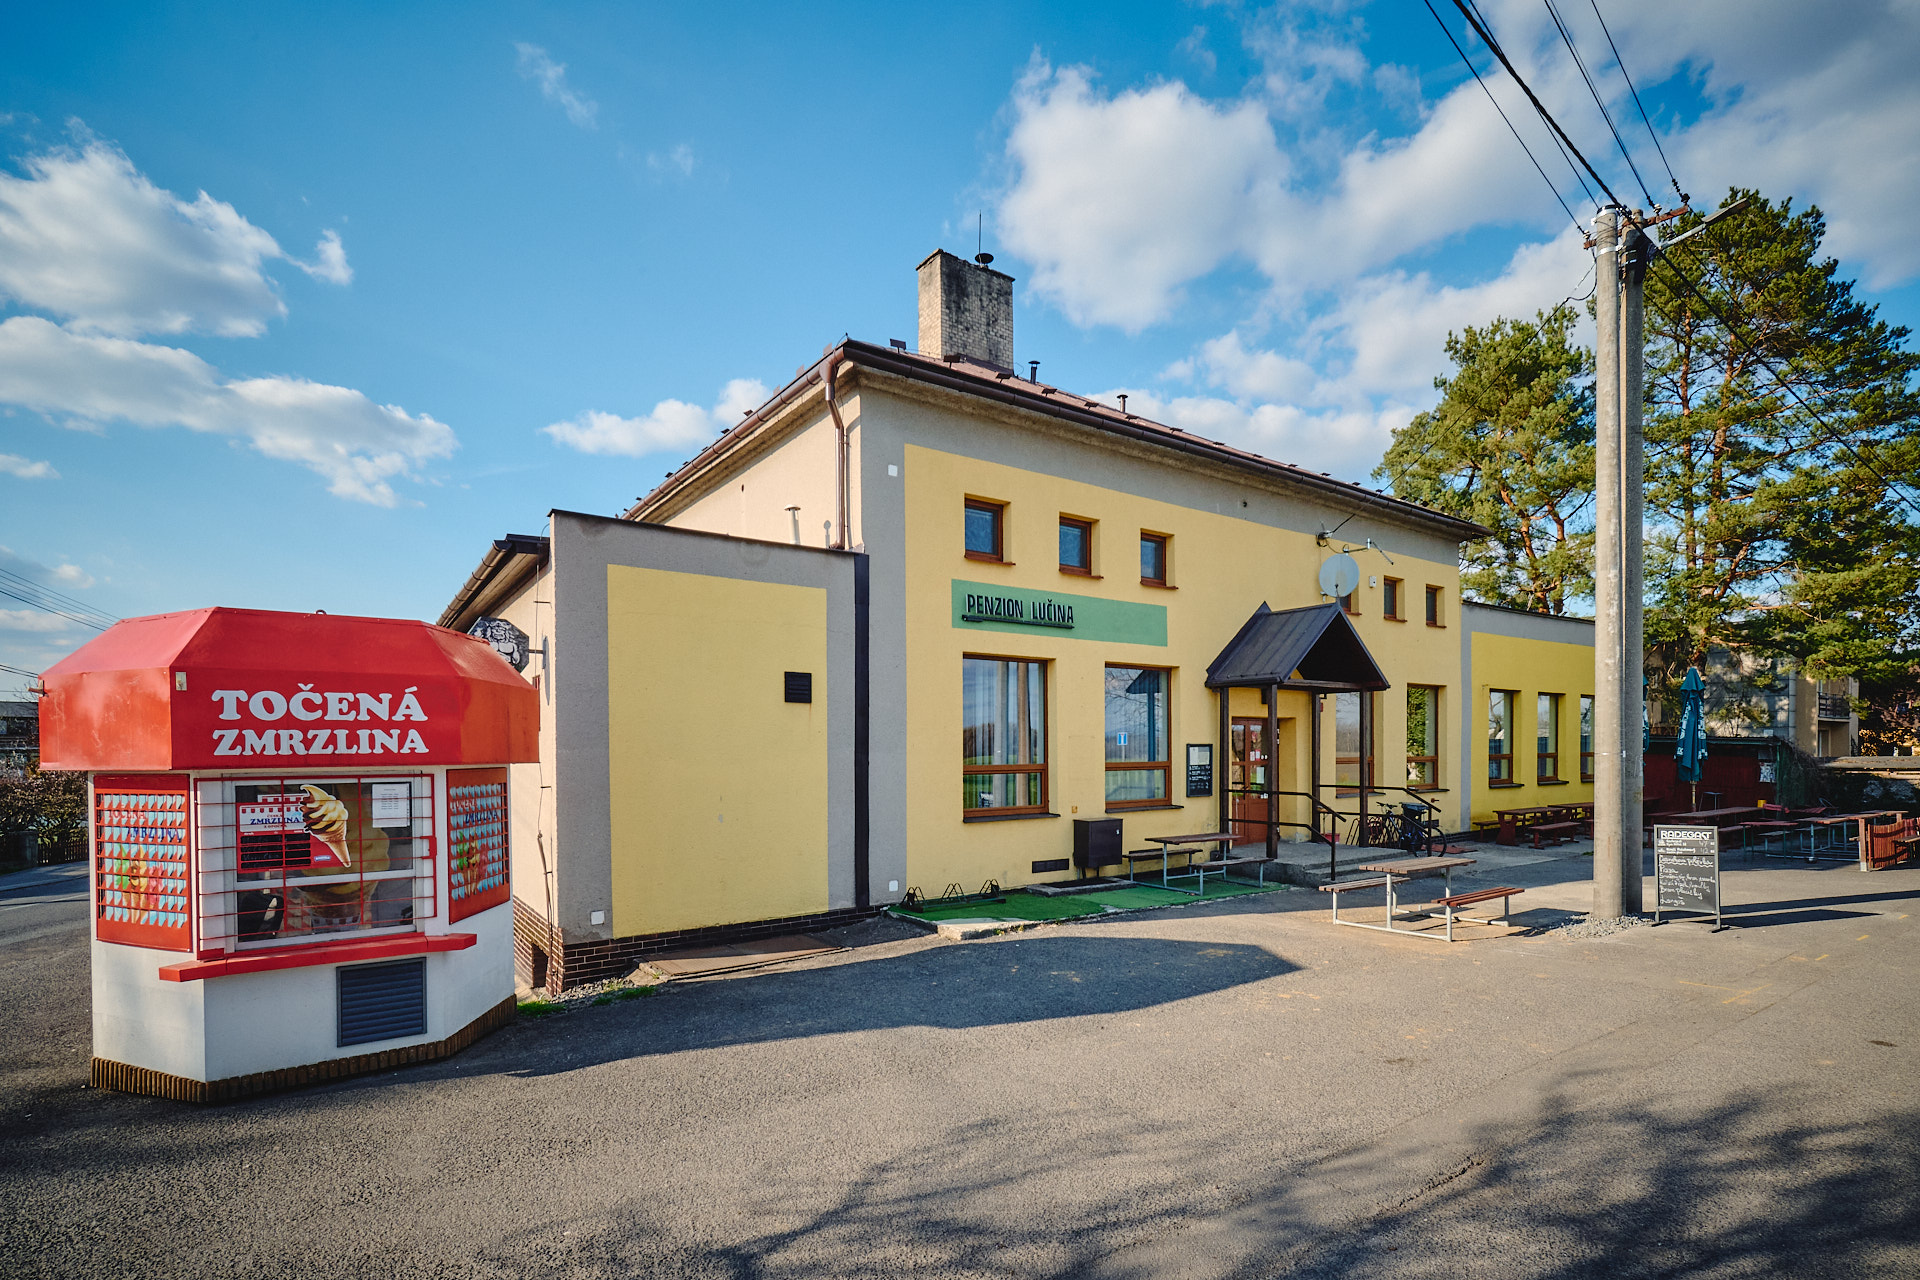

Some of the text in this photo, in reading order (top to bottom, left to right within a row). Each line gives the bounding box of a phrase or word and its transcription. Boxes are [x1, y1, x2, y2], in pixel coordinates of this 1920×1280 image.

[965, 593, 1075, 623] PENZION LUČINA
[211, 683, 429, 722] TOČENÁ
[212, 729, 430, 756] ZMRZLINA
[1660, 831, 1712, 840] RADEGAST
